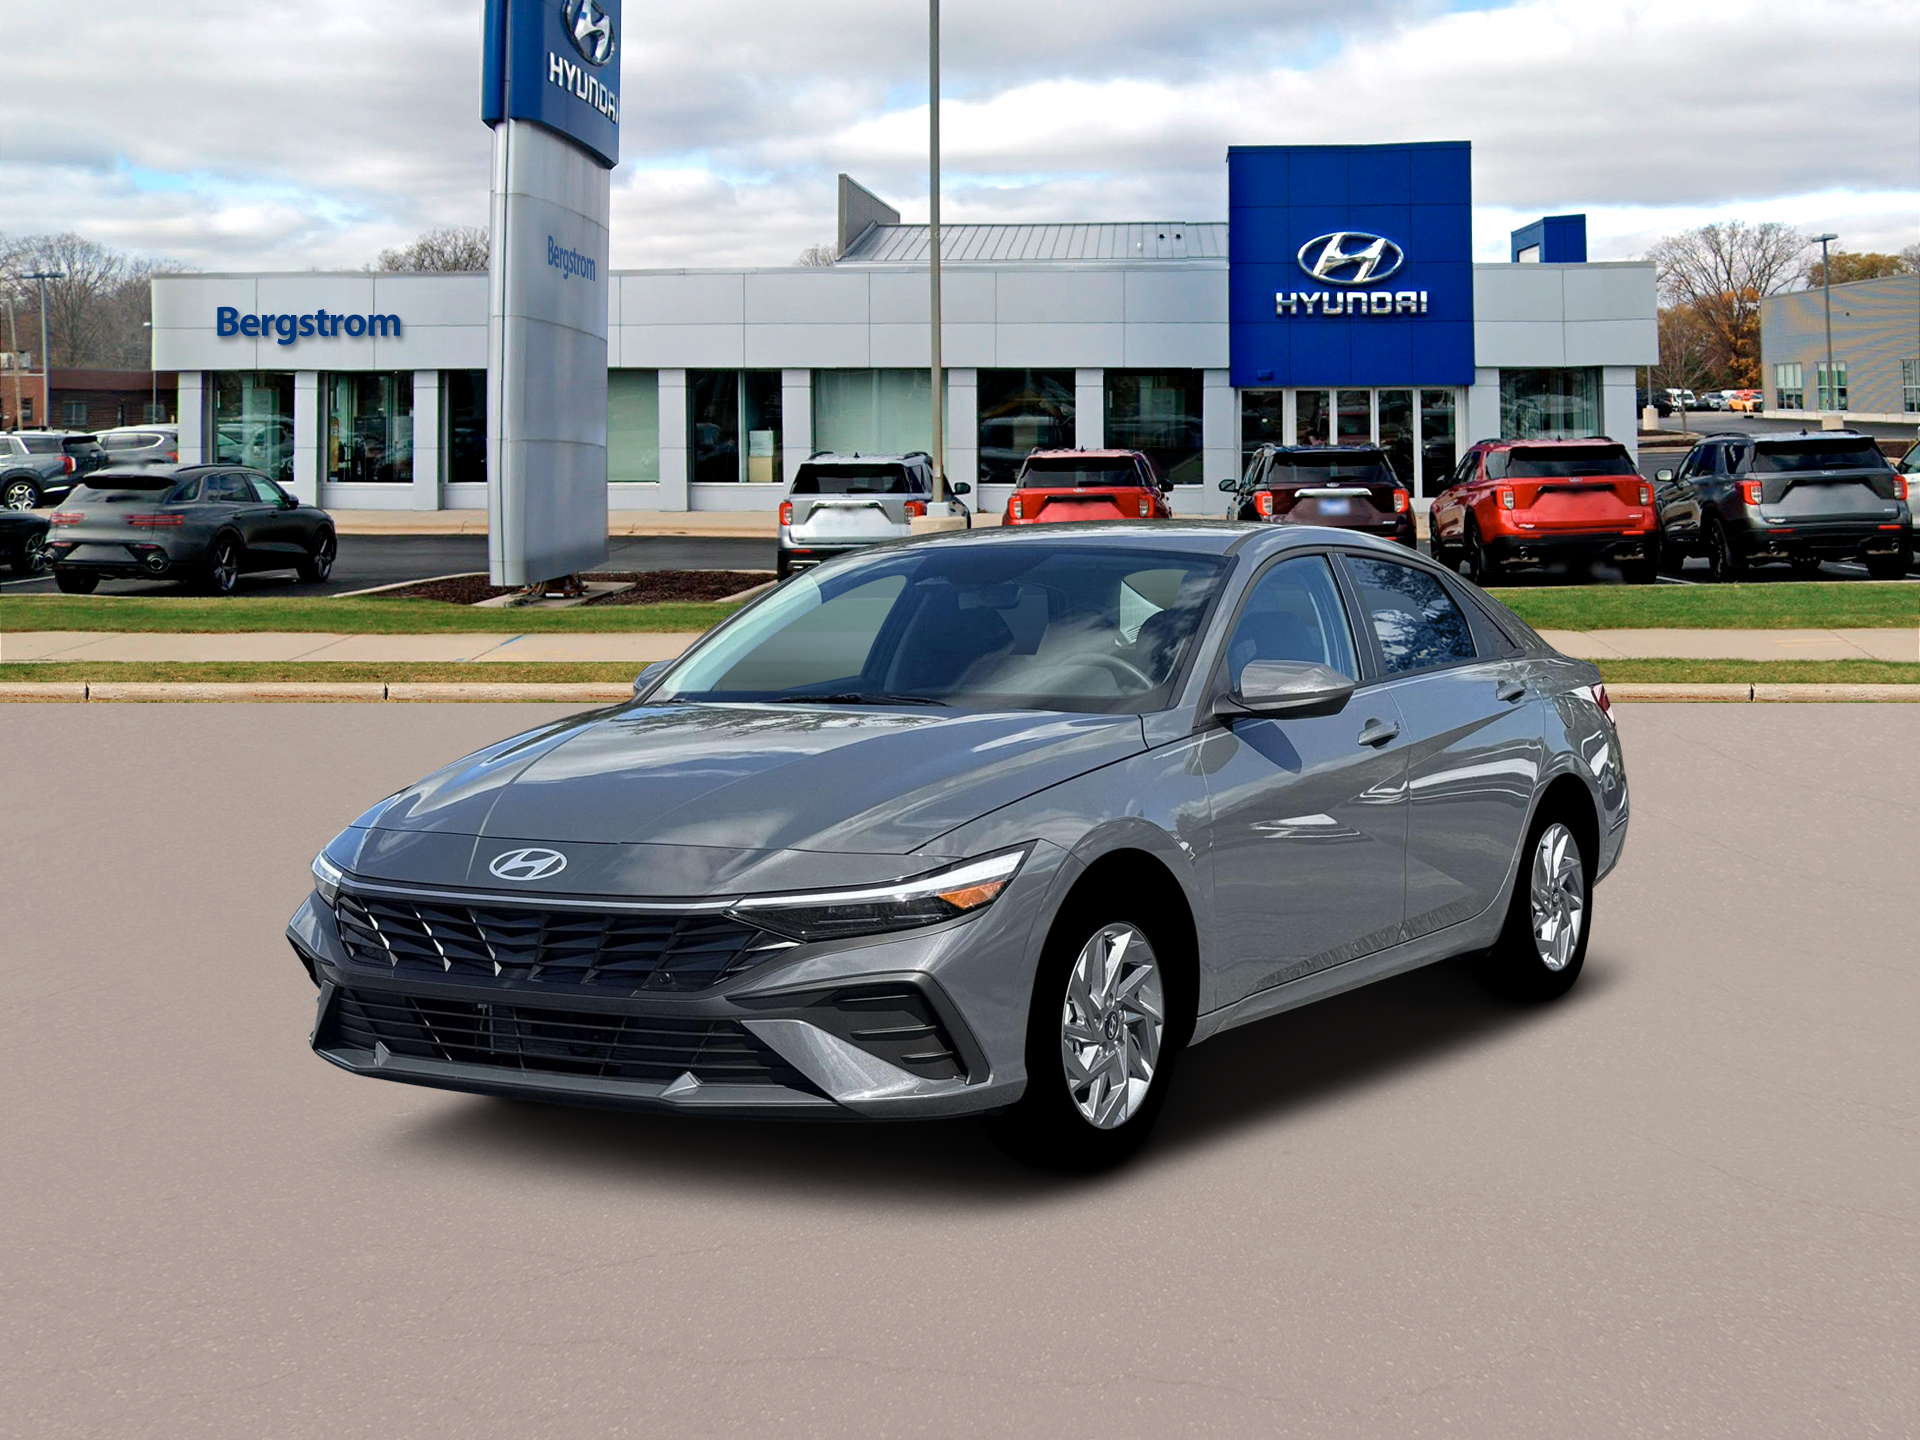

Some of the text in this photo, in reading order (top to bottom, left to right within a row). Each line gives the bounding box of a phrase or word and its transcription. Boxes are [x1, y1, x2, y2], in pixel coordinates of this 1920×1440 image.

[549, 51, 619, 124] HYUNDAI
[547, 235, 596, 282] Bergstrom
[1275, 291, 1428, 315] HYUNDAI
[216, 306, 402, 346] Bergstrom
